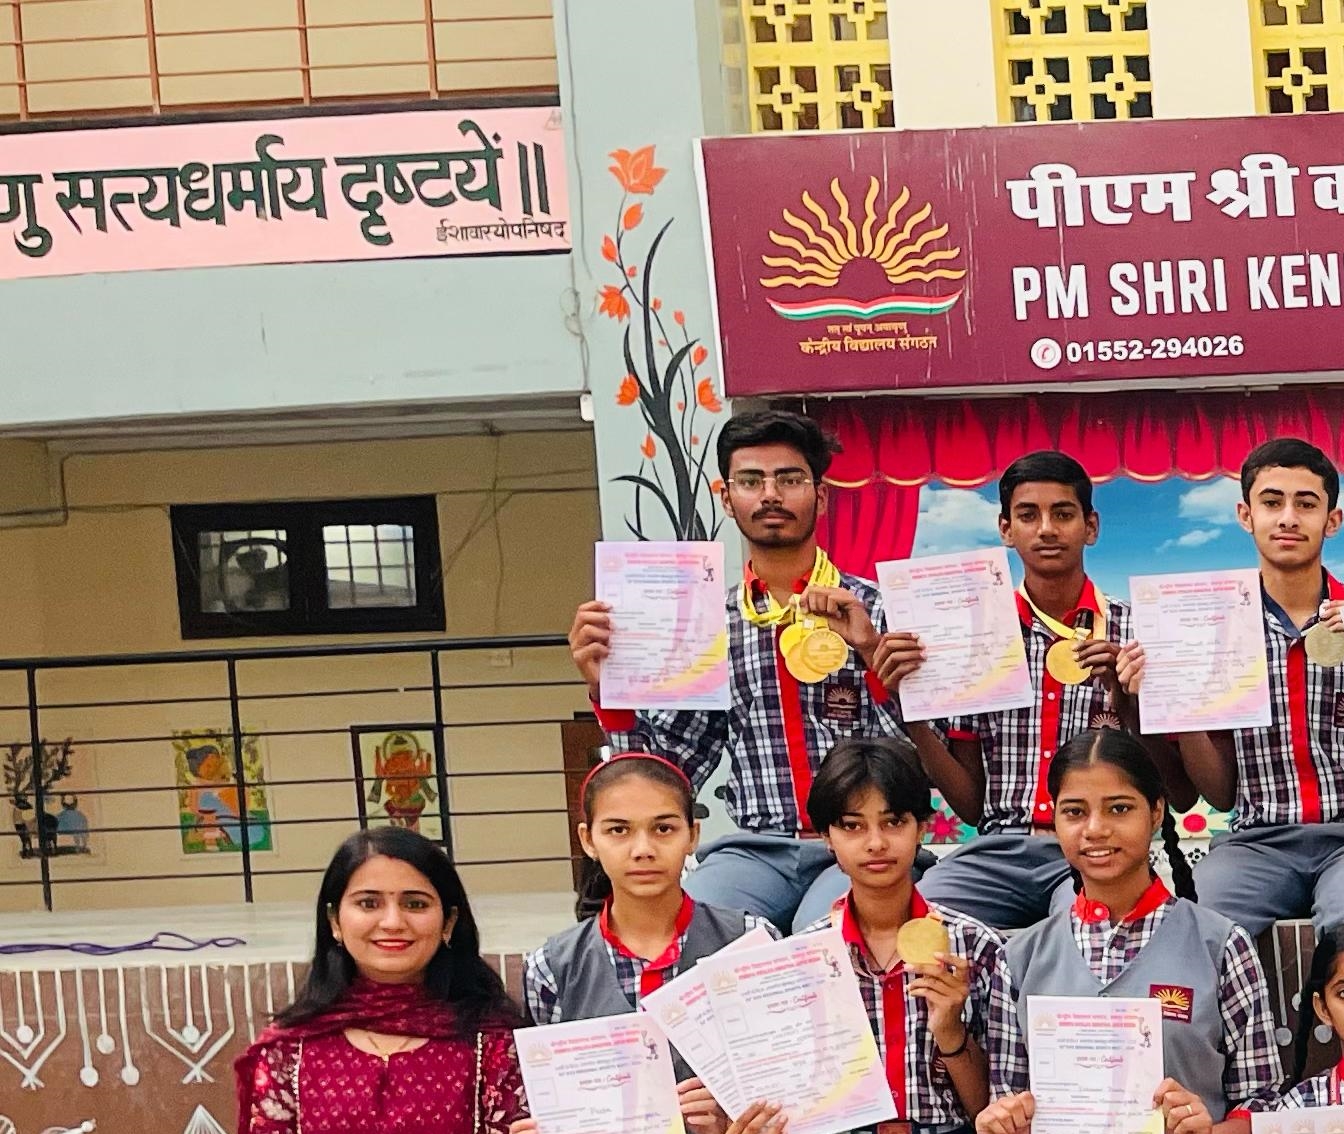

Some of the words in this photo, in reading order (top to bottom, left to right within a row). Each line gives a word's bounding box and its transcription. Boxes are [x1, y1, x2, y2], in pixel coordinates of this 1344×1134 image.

[52, 134, 328, 235] सत्यधर्माय
[1005, 163, 1197, 228] पीएम
[1205, 153, 1301, 219] श्री
[1012, 264, 1089, 321] PM
[1109, 258, 1228, 317] SHRI
[843, 335, 896, 352] विद्यालय
[897, 334, 938, 351] संगठन
[1066, 335, 1244, 363] 01552-294026
